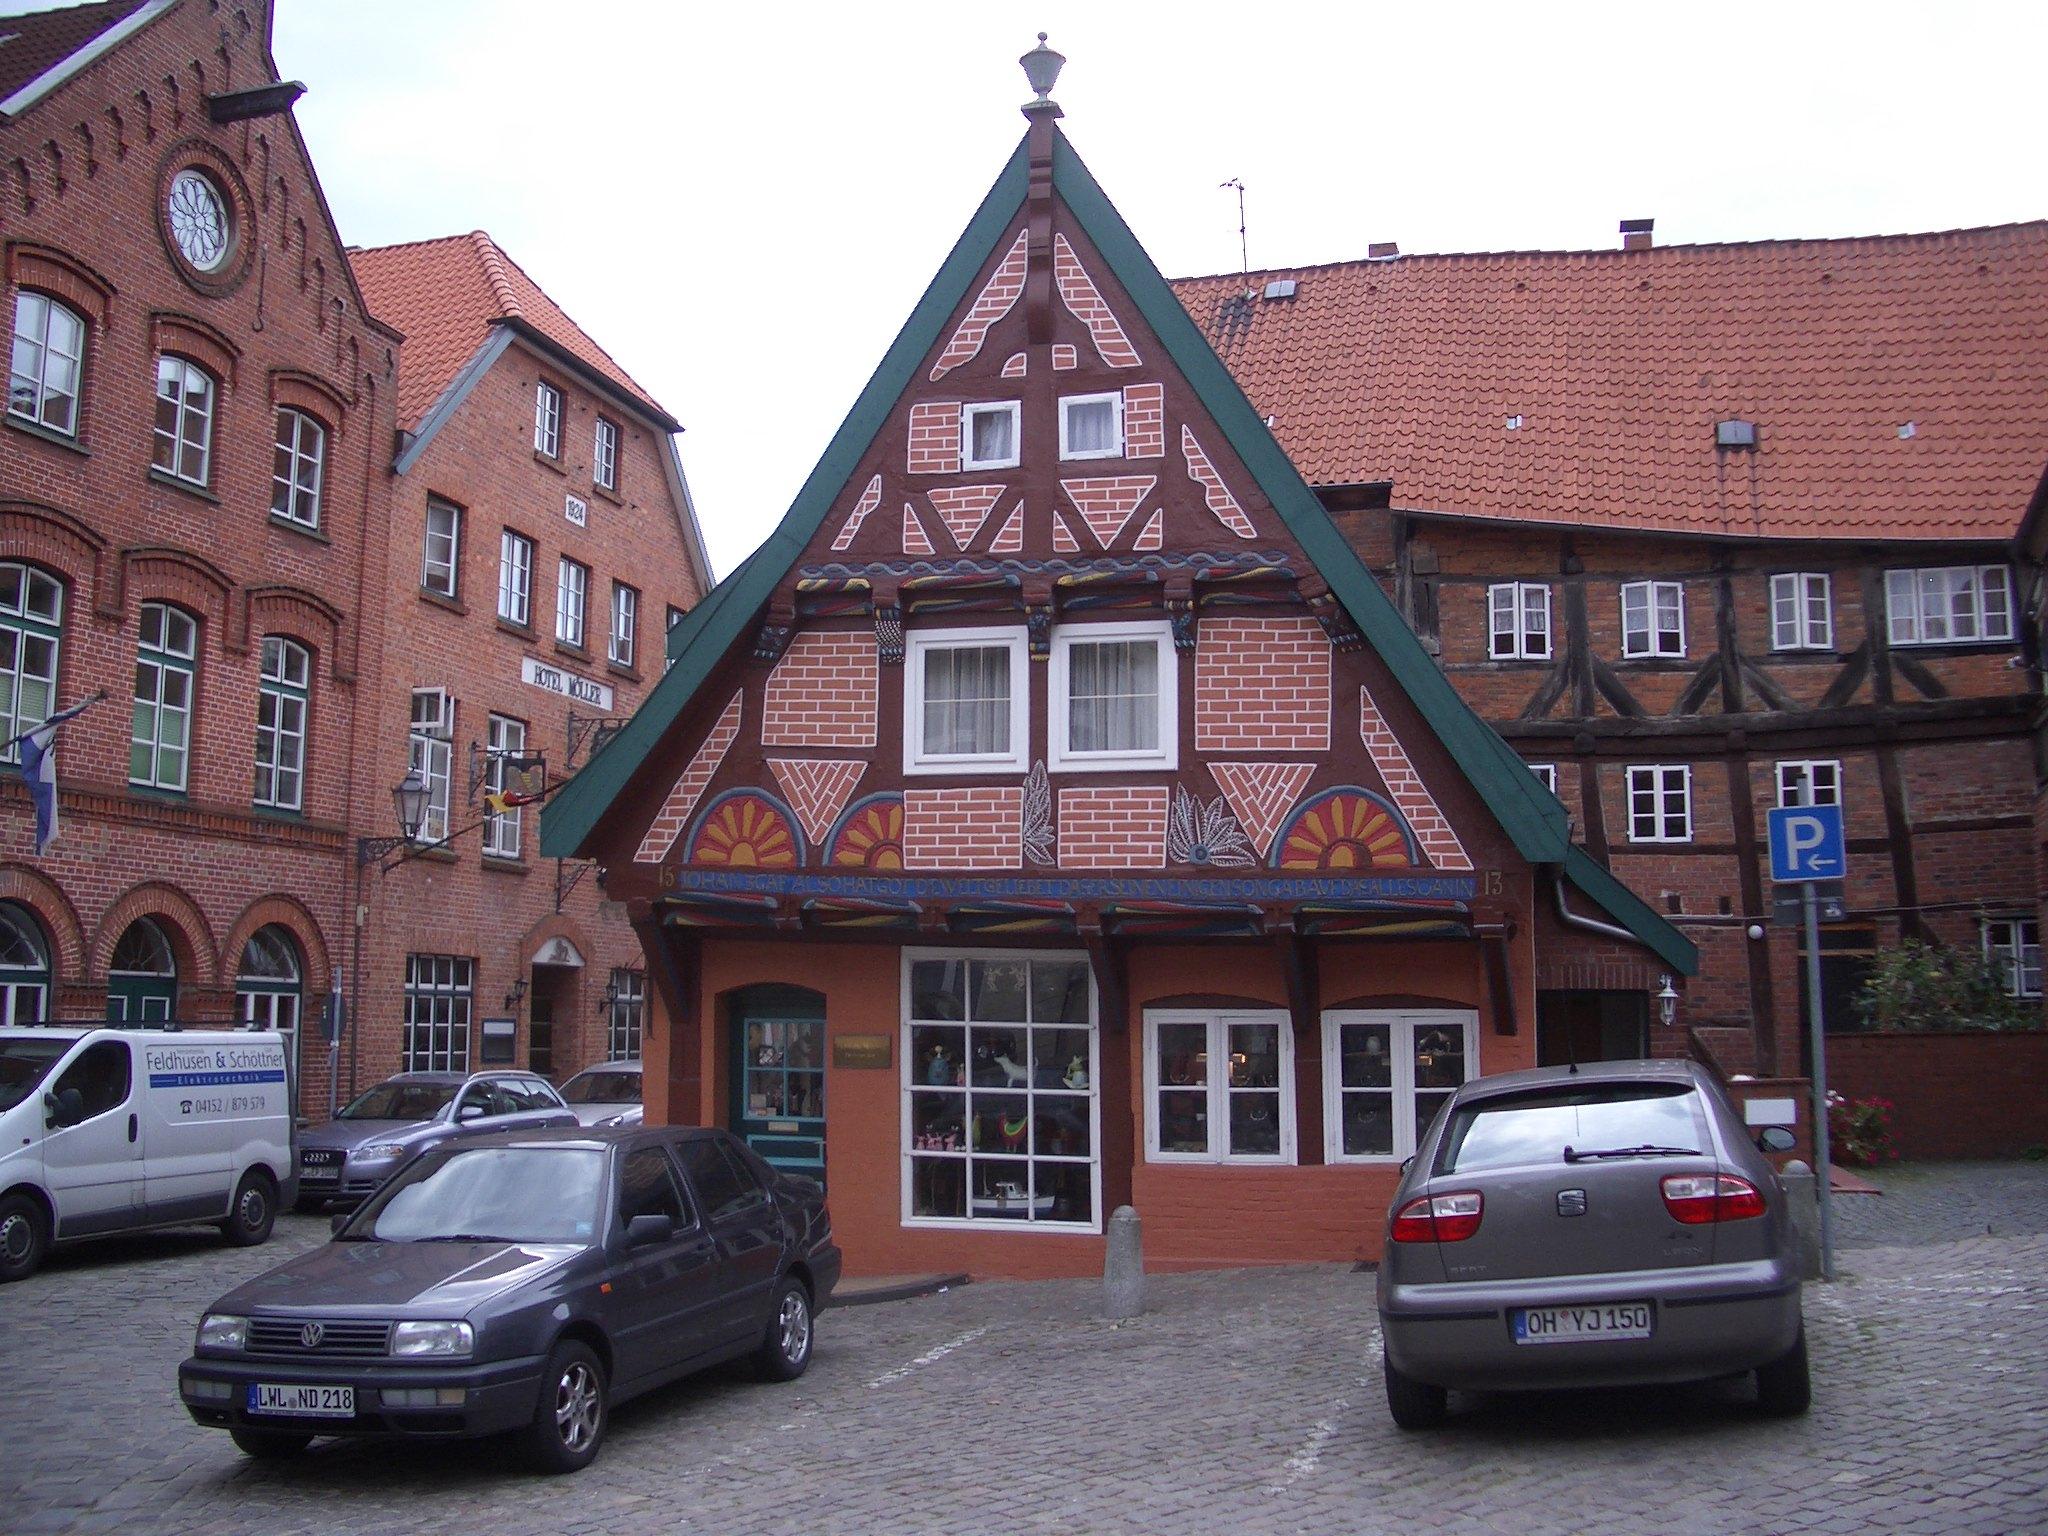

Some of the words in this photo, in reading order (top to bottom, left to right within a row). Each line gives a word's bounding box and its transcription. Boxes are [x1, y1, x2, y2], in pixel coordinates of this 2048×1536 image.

[568, 500, 584, 522] 1924
[534, 664, 563, 693] HOTEL
[568, 675, 602, 705] MÖLLER
[1785, 816, 1825, 871] P
[147, 1052, 212, 1071] Feldhusen
[216, 1051, 225, 1068] &
[230, 1049, 283, 1068] Schöttner
[177, 1074, 261, 1085] Elektrotechnik
[195, 1099, 222, 1114] 04152
[231, 1097, 248, 1111] 879
[250, 1096, 265, 1111] 579
[1528, 1311, 1557, 1335] OH
[1573, 1308, 1601, 1332] YJ
[1606, 1306, 1647, 1331] 150
[258, 1387, 287, 1407] LWL
[298, 1389, 319, 1408] ND
[322, 1389, 352, 1409] 218
